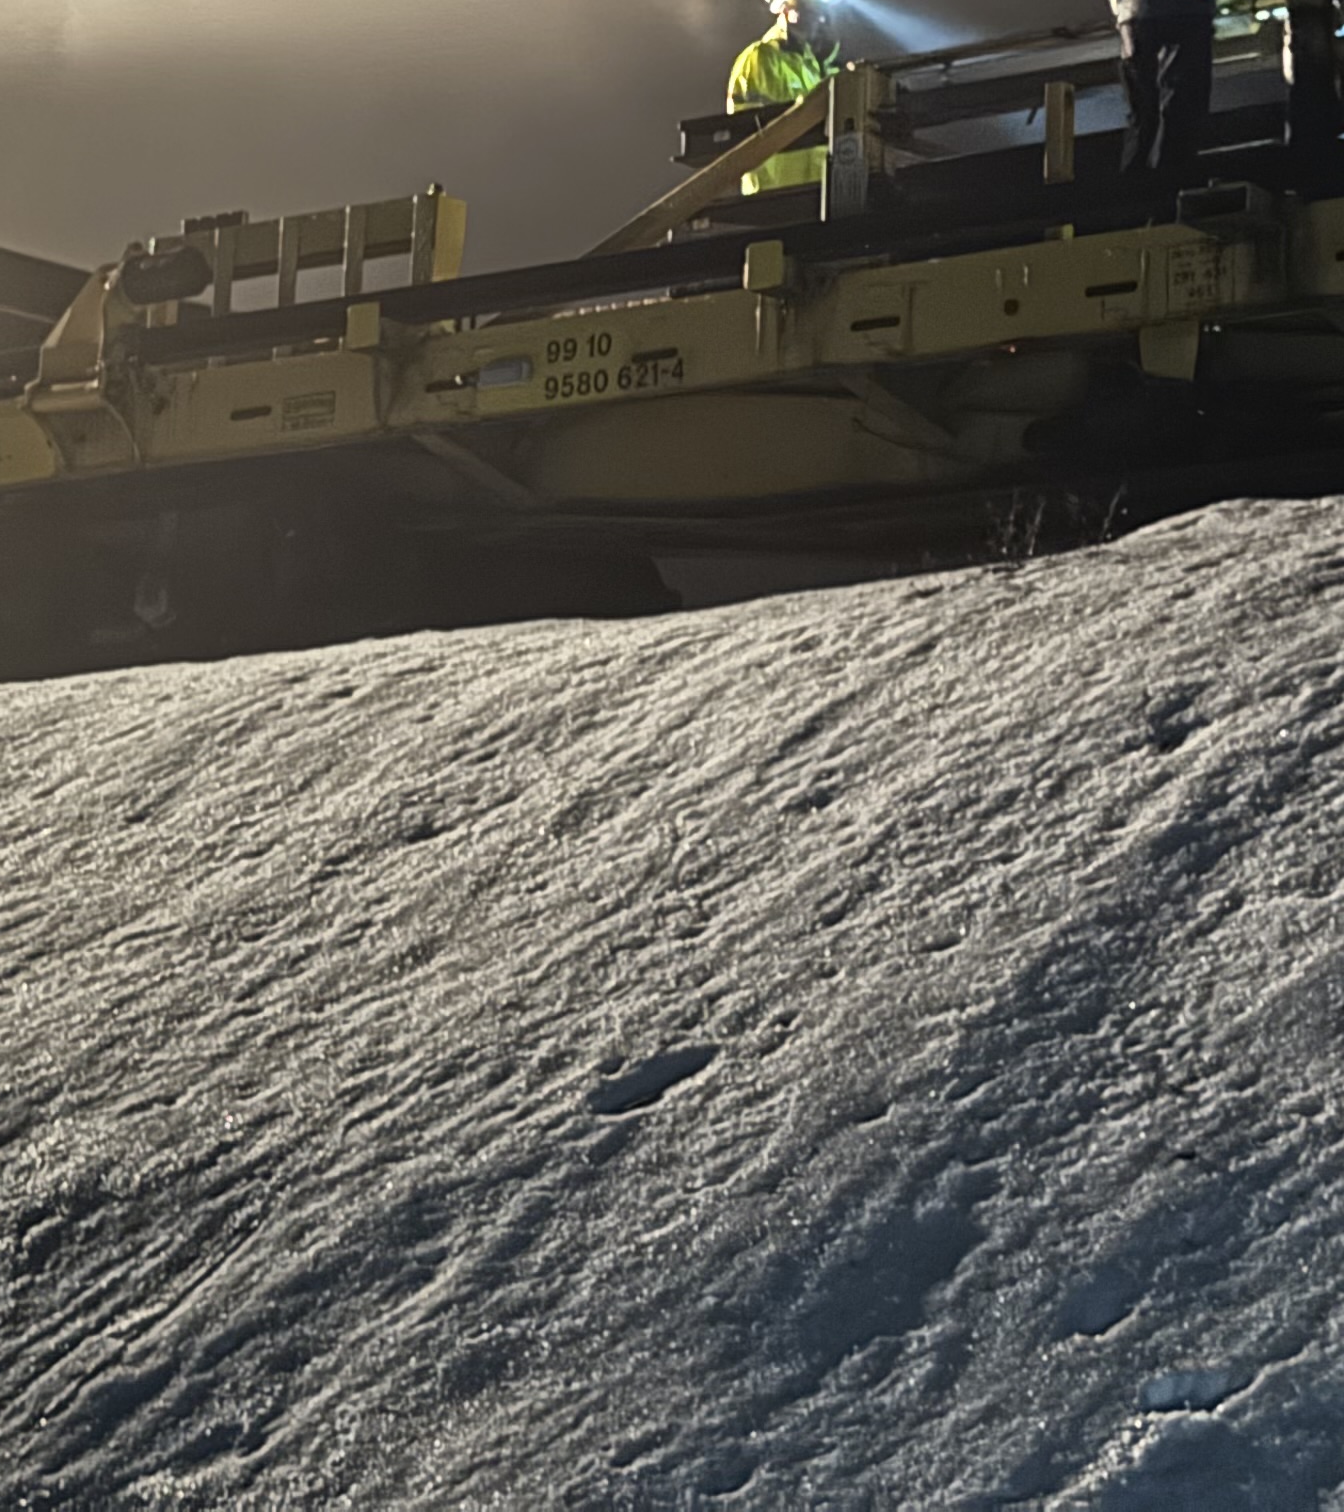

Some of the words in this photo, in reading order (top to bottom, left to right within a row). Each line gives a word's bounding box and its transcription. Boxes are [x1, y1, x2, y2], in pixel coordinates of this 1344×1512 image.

[546, 338, 578, 364] 99
[587, 332, 613, 358] 10
[545, 369, 609, 400] 9580
[617, 358, 684, 390] 621-4
